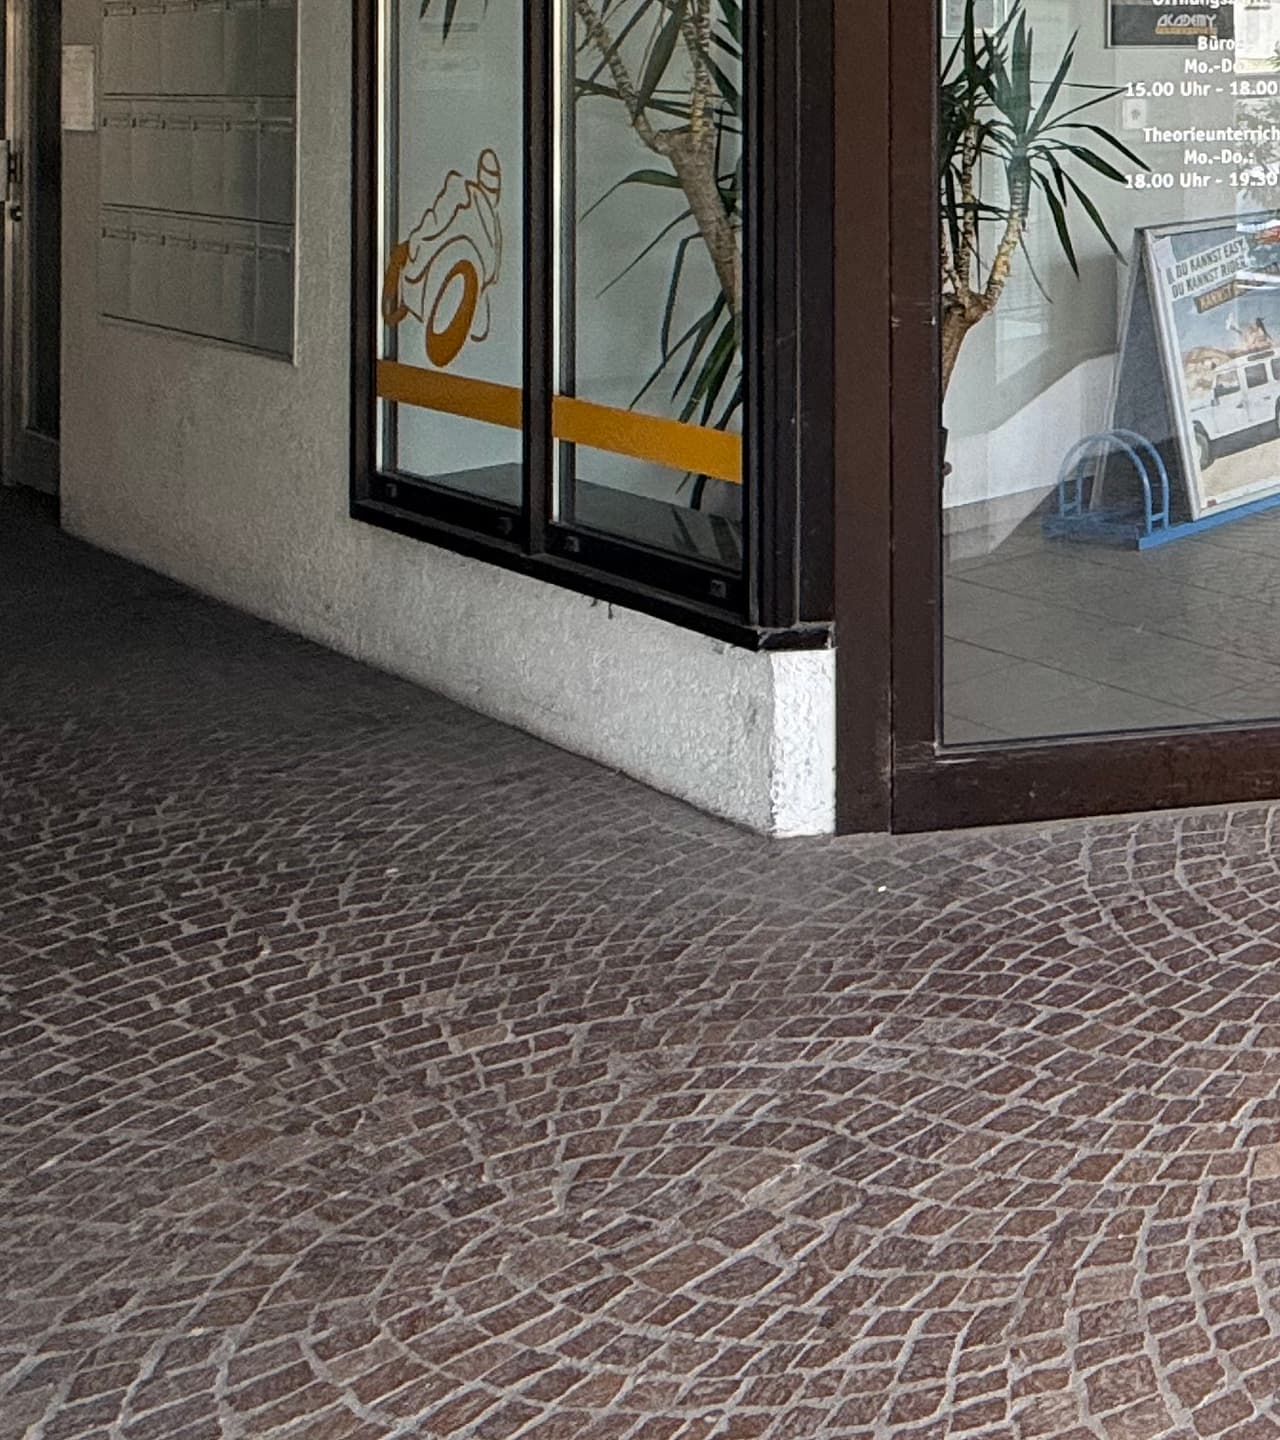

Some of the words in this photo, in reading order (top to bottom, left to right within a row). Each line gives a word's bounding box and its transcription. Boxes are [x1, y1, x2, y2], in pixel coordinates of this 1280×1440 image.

[1125, 81, 1174, 97] 15.00
[1180, 81, 1211, 97] Uhr
[1229, 80, 1278, 96] 18.00
[1125, 173, 1174, 189] 18.00
[1179, 173, 1211, 188] Uhr
